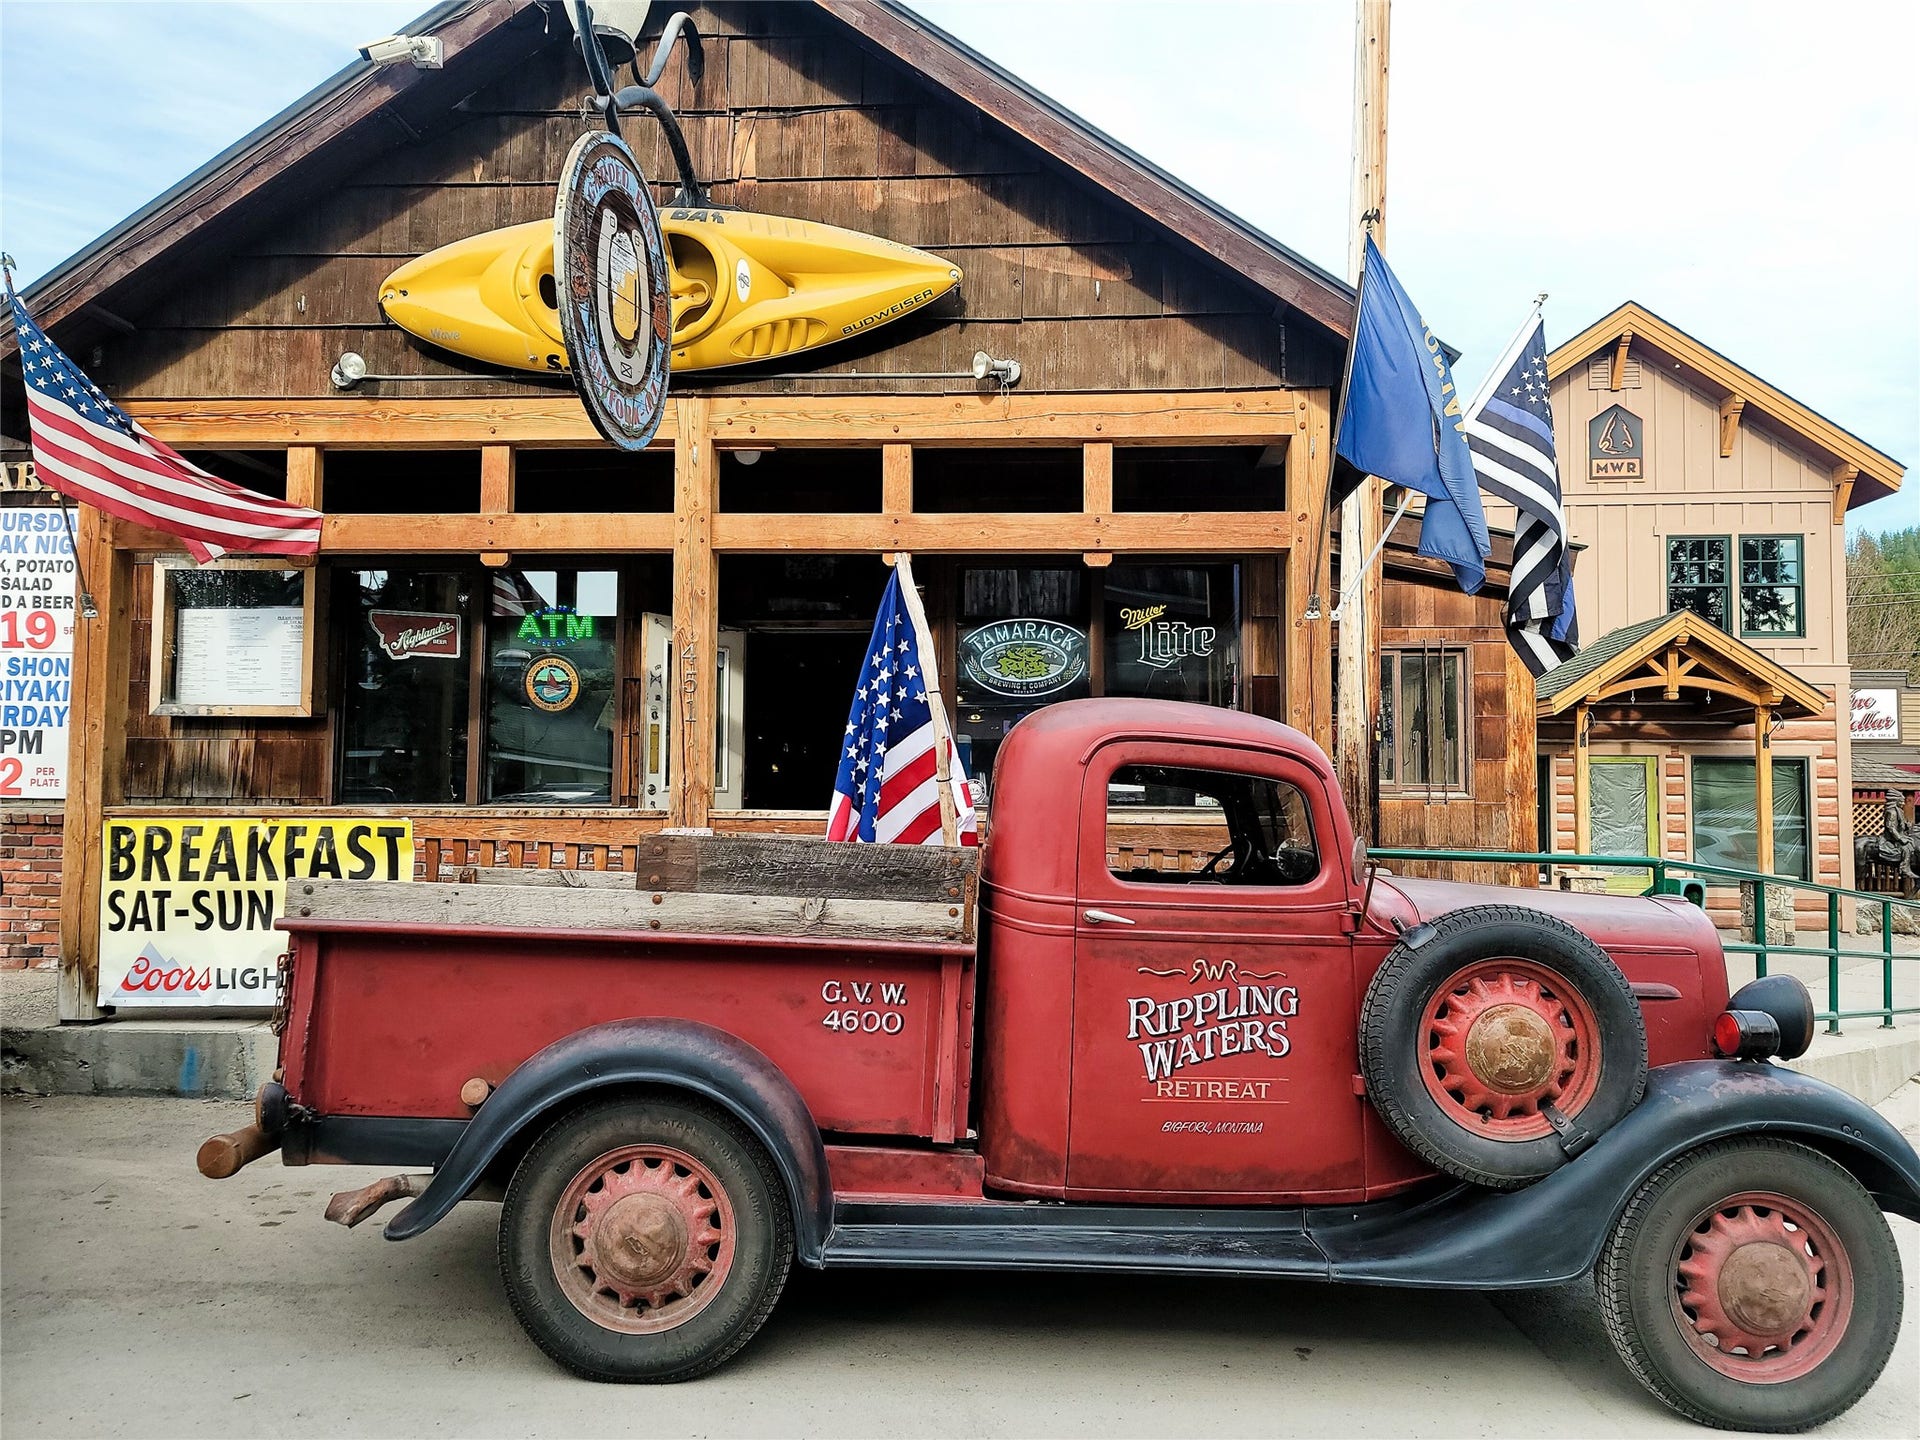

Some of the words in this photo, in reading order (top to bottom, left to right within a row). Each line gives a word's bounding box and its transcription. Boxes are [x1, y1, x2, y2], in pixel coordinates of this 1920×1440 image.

[842, 289, 934, 334] BUDWEISER
[431, 328, 461, 340] Wave
[1596, 462, 1637, 473] MWR
[0, 512, 77, 532] URSDA
[16, 559, 75, 573] POTATO
[1, 577, 53, 591] SALAD
[16, 595, 27, 608] A
[32, 595, 74, 609] BEER
[1120, 604, 1167, 625] Miller
[1, 611, 56, 650] 19
[390, 621, 454, 650] Highlander
[517, 614, 593, 638] ATM
[970, 622, 1078, 652] TAMARACK
[1137, 622, 1216, 668] Lite
[6, 657, 70, 677] SHON
[0, 680, 70, 702] IYAKI
[988, 677, 1021, 689] BREWING
[1028, 676, 1062, 689] COMPANY
[0, 705, 69, 728] RDAY
[1850, 711, 1896, 732] ellar
[0, 729, 43, 754] PM
[36, 767, 55, 776] PER
[30, 778, 60, 788] PLATE
[109, 825, 406, 881] BREAKFAST
[107, 889, 274, 932] SAT-SUN
[120, 956, 212, 991] Coors
[822, 1010, 903, 1033] 4600
[1127, 985, 1300, 1040] RIPPLING
[1138, 1020, 1291, 1082] WATERS
[1156, 1080, 1271, 1099] RETREAT
[1161, 1121, 1213, 1135] BIGFORK,
[1214, 1122, 1264, 1133] MONTANA
